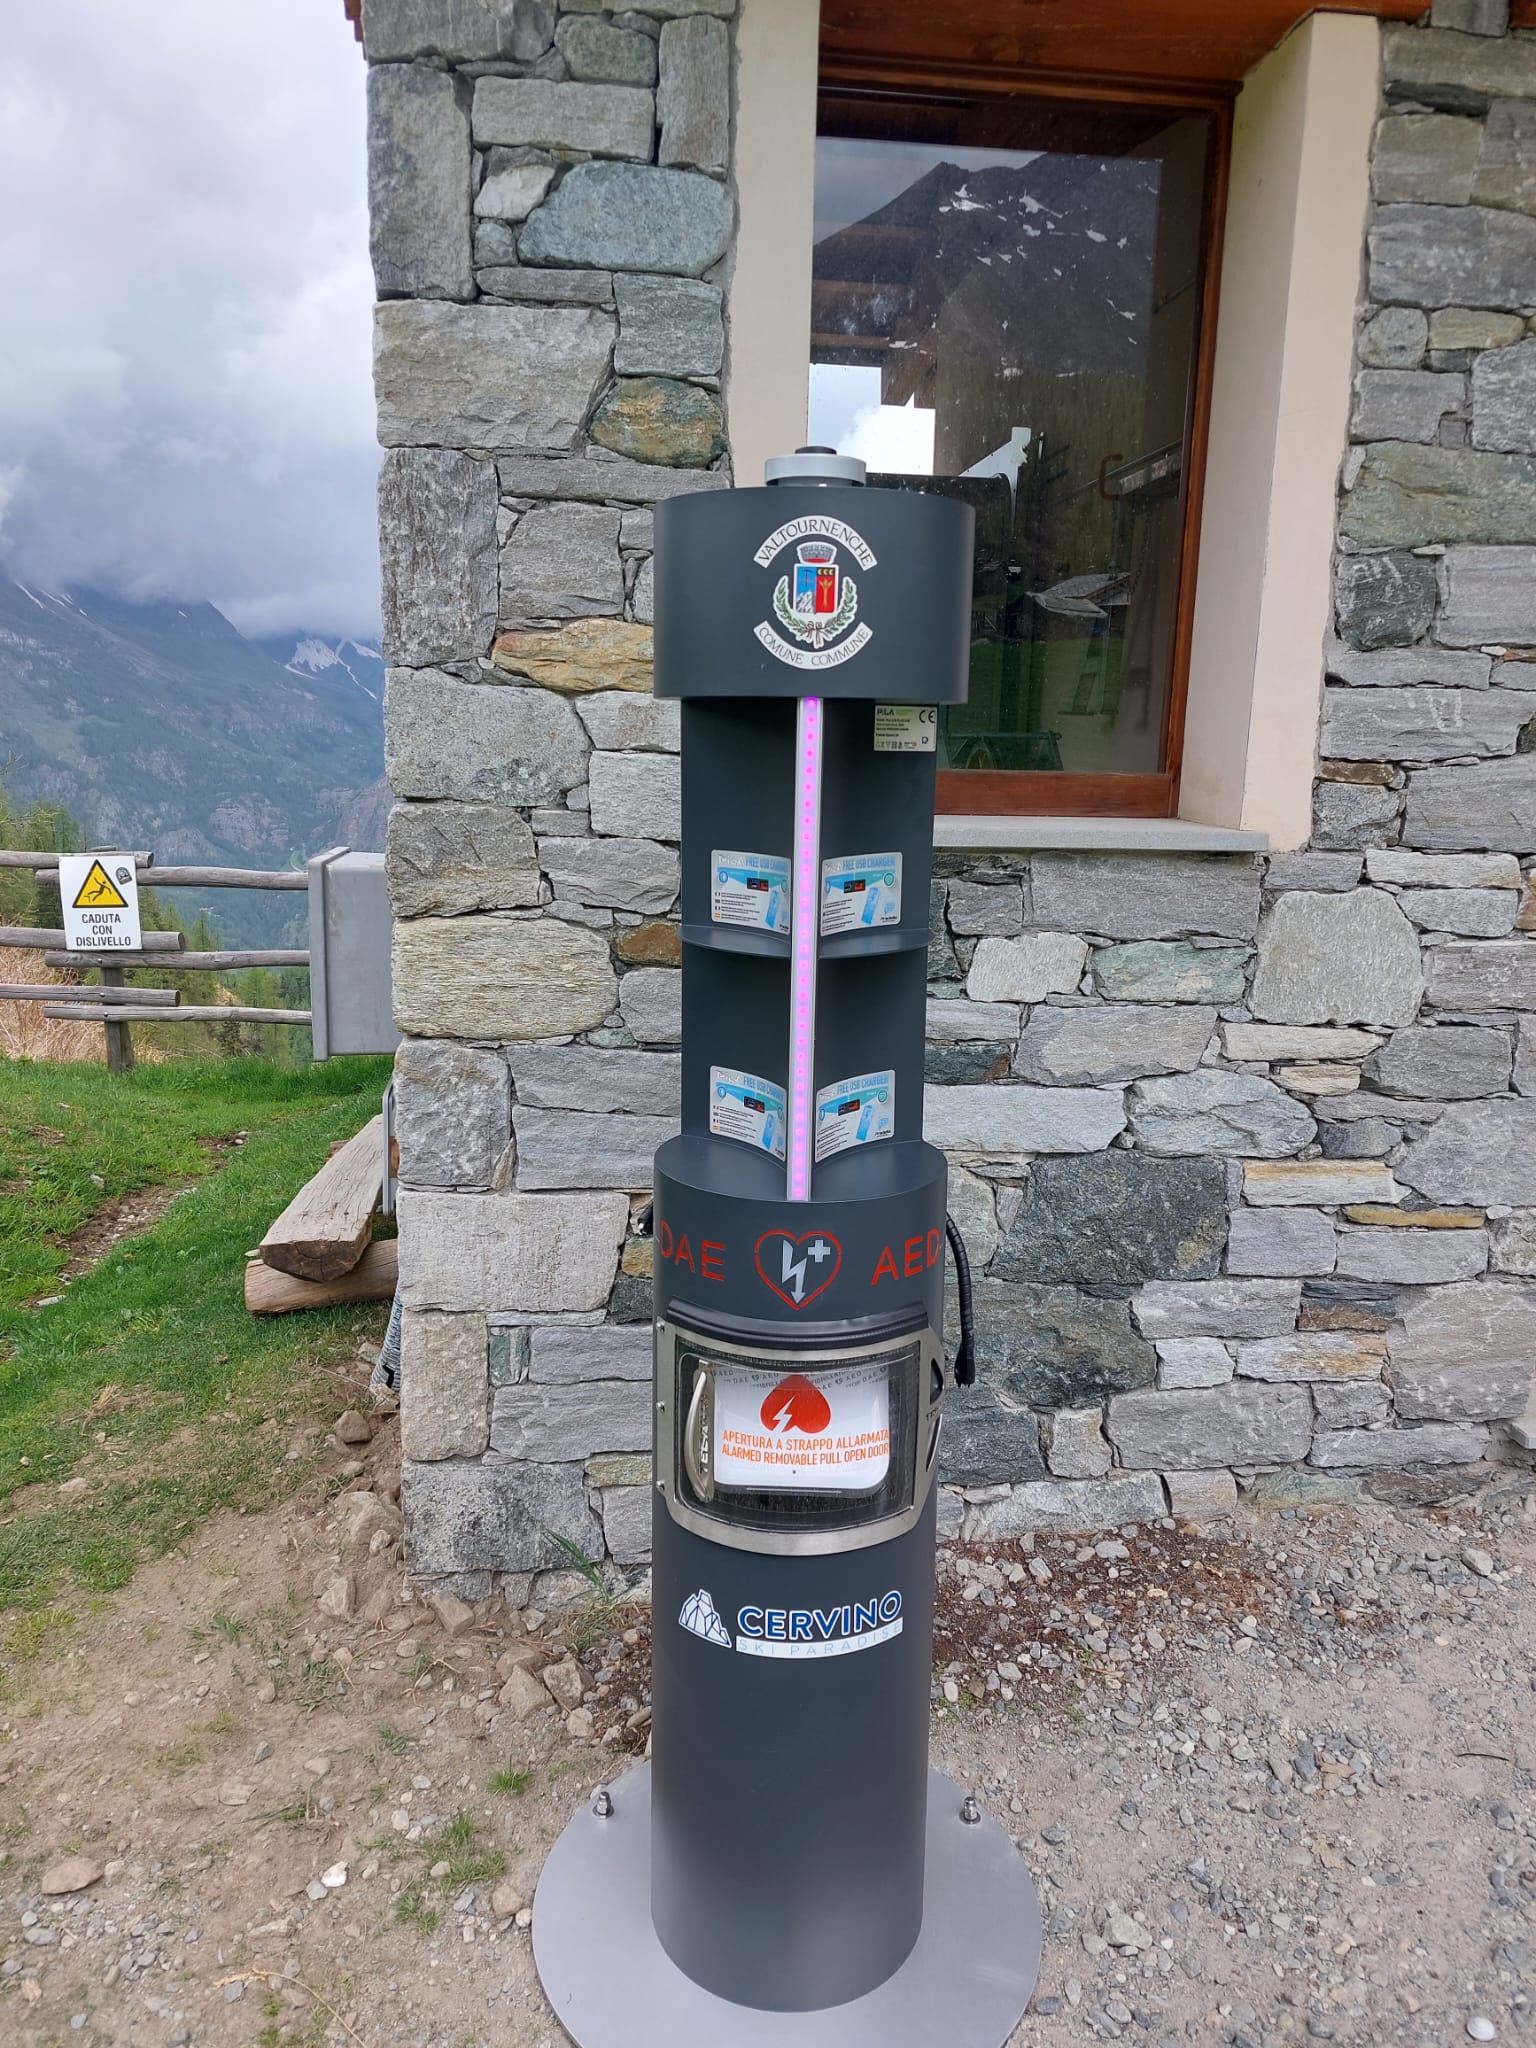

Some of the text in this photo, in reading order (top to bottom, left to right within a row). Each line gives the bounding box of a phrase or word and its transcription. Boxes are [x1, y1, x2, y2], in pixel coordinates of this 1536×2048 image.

[758, 519, 873, 567] VALTOURNENCHE
[758, 626, 869, 666] COMUNE COMMUNE
[81, 913, 121, 924] CADUTA
[92, 925, 112, 935] CON
[76, 936, 131, 946] DISLIVELLO
[659, 1219, 941, 1286] DAE AED
[721, 1442, 889, 1465] ALARMED REMOVABLE PULL OPEN DOOR
[722, 1429, 890, 1451] APERTURA A STRAPPO ALLARMATA
[738, 1591, 901, 1638] CERVINO
[738, 1622, 901, 1656] SKI PARADISE
